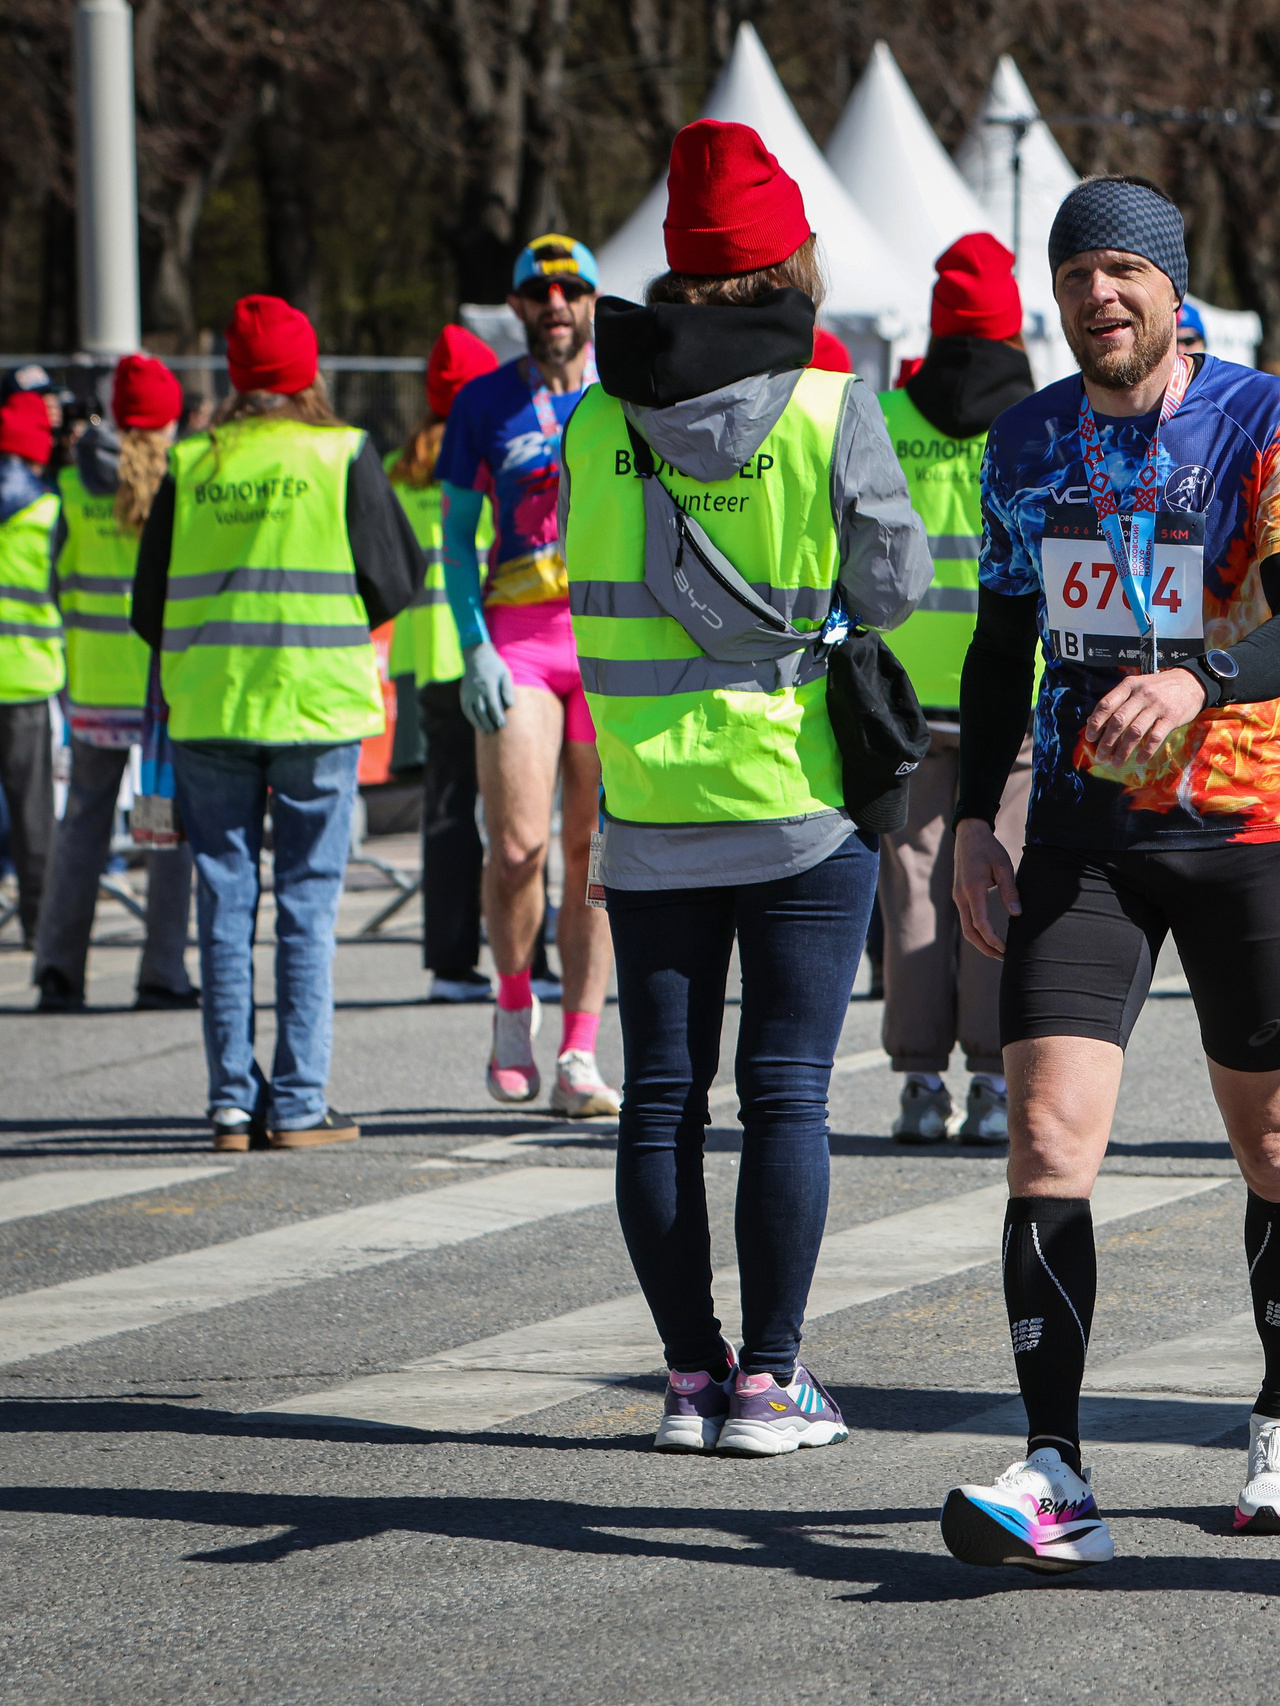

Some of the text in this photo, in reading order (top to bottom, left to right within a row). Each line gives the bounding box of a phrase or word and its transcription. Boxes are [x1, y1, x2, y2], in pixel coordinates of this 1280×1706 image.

[896, 438, 986, 460] ВОЛОНТ
[1053, 525, 1090, 535] 2026
[1131, 524, 1139, 576] МОСКОВСКИЙ
[673, 568, 723, 629] BYD
[1065, 632, 1079, 656] B
